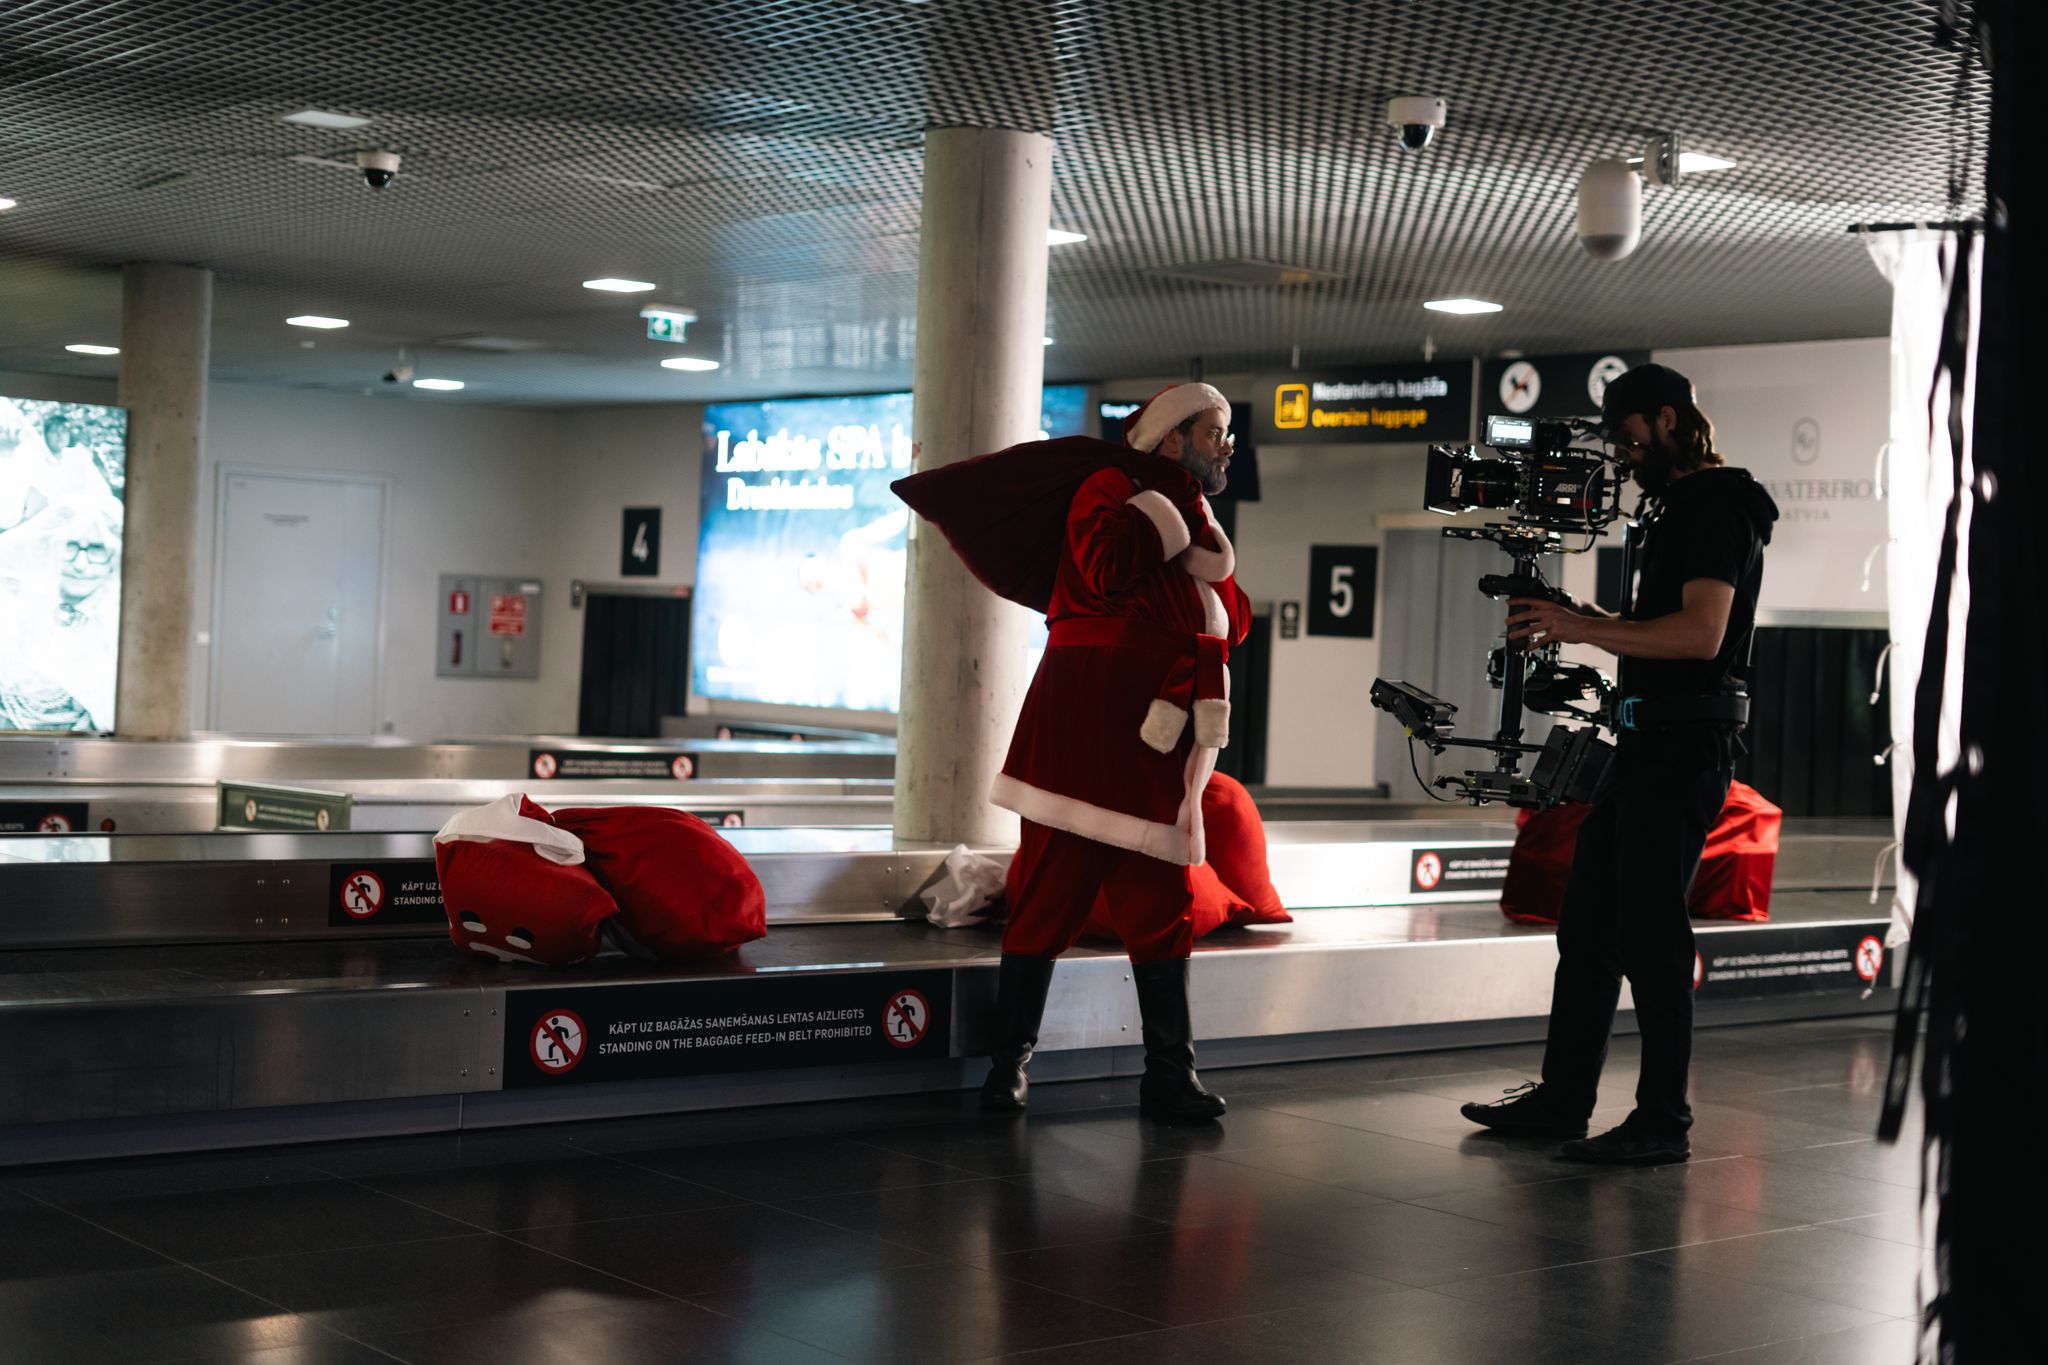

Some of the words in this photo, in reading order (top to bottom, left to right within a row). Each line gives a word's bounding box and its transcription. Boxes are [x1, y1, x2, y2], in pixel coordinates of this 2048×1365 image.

[1312, 380, 1395, 401] Nestandarta
[1312, 408, 1369, 427] Oversize
[1372, 407, 1427, 429] luggage
[826, 423, 887, 470] SPA
[1554, 483, 1577, 494] ARRI
[631, 521, 649, 562] 4
[1329, 566, 1355, 618] 5
[402, 881, 424, 891] KĀPT
[425, 882, 437, 891] UZ
[393, 896, 436, 906] STANDING
[609, 1021, 637, 1035] KĀPT
[639, 1022, 653, 1033] UZ
[655, 1016, 703, 1032] BAGĀŽAS
[705, 1013, 774, 1030] SAŅEMŠANAS
[777, 1011, 814, 1024] LENTAS
[816, 1008, 865, 1022] AIZLIEGTS
[599, 1040, 653, 1054] STANDING
[655, 1039, 671, 1051] ON
[673, 1037, 693, 1049] THE
[695, 1034, 743, 1048] BAGGAGE
[746, 1031, 786, 1044] FEED-IN
[788, 1030, 813, 1041] BELT
[815, 1025, 872, 1039] PROHIBITED
